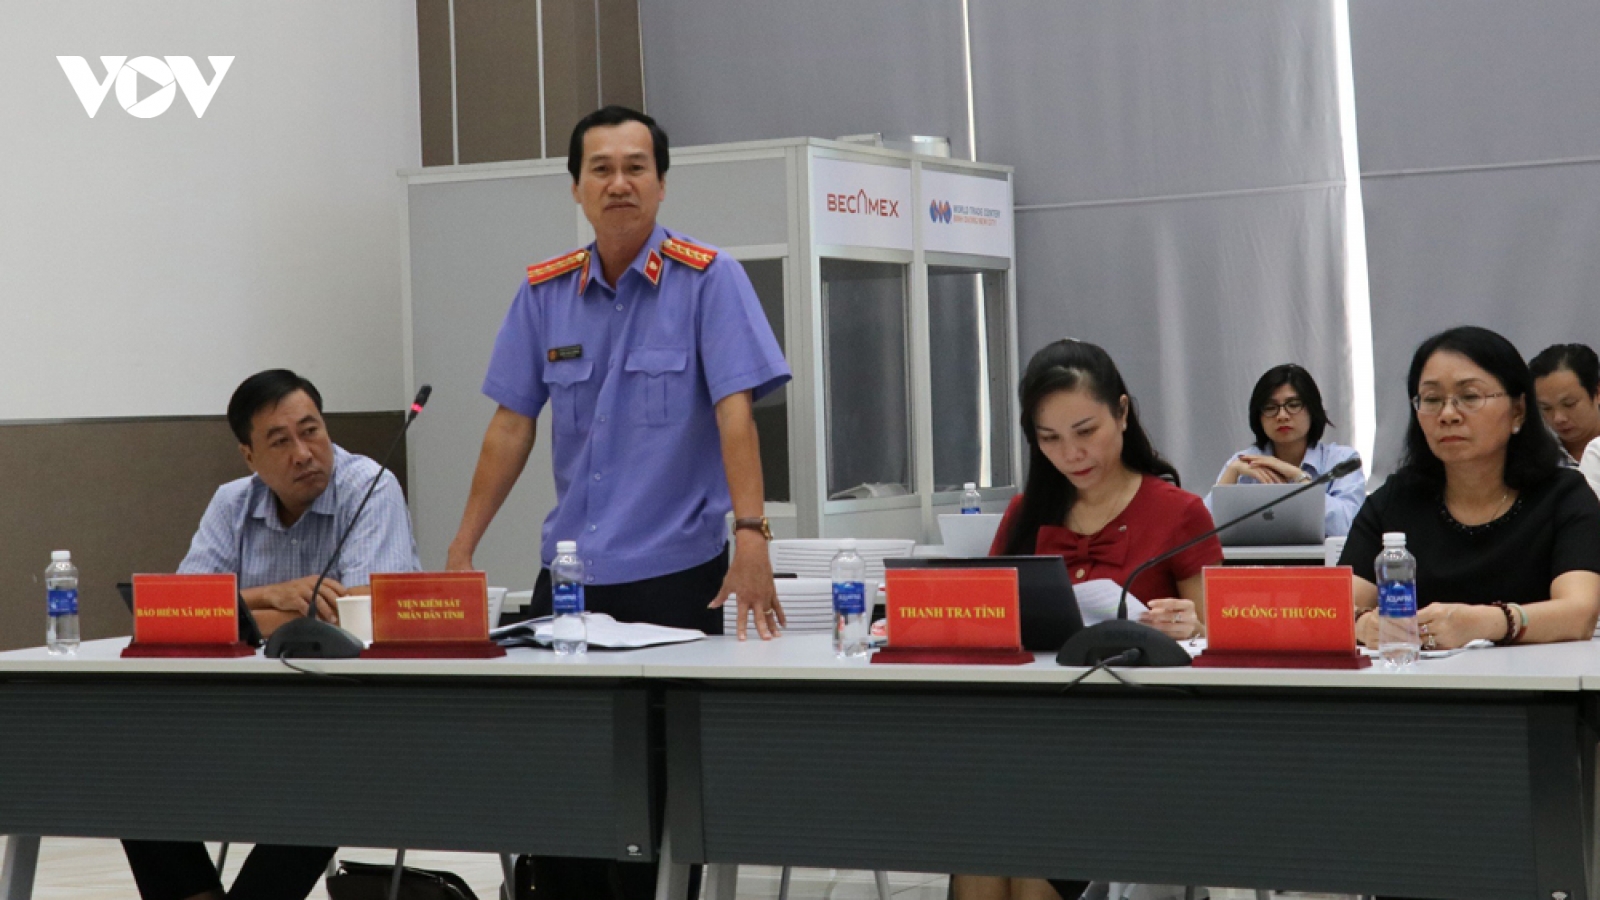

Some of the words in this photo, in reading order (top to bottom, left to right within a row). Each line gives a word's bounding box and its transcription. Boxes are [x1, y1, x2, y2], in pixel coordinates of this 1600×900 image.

[826, 189, 900, 218] BECAMEX
[397, 599, 419, 610] VIỆN
[444, 597, 461, 608] SÁT
[181, 606, 193, 617] XÃ
[194, 607, 212, 619] HỘI
[397, 609, 422, 619] NHÂN
[423, 609, 441, 619] DÂN
[899, 606, 943, 619] THANH
[945, 606, 972, 619] TRA
[973, 603, 1006, 619] TỈNH
[1221, 604, 1239, 619] SỞ
[1241, 603, 1278, 619] CÔNG
[1280, 605, 1337, 619] THƯƠNG
